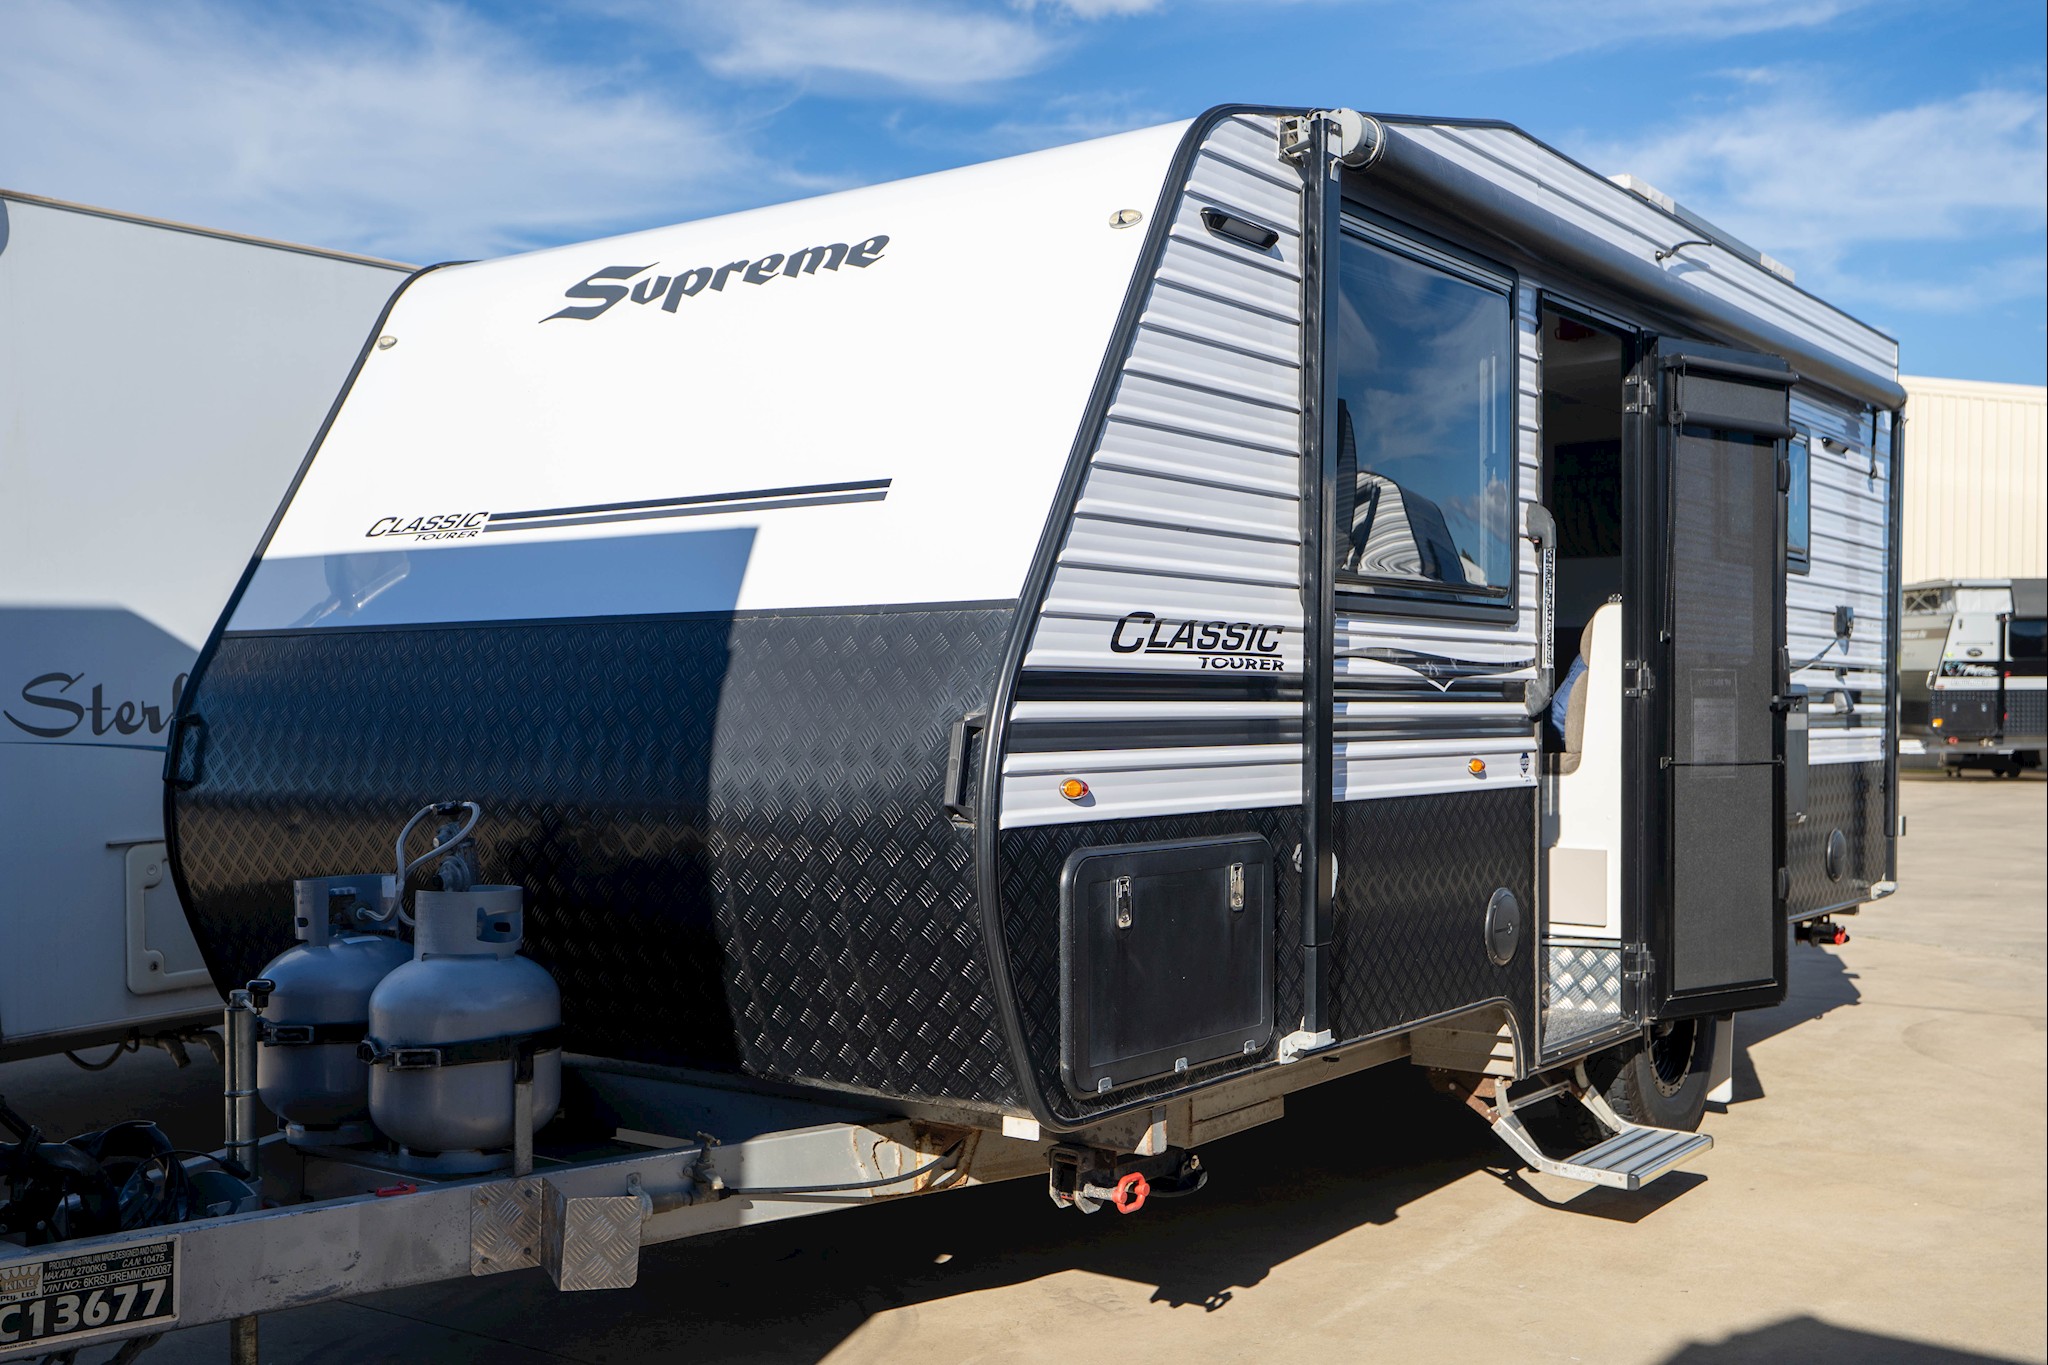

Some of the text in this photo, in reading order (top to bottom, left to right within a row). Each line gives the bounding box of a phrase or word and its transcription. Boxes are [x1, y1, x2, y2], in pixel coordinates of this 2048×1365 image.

[538, 233, 890, 324] Supreme
[365, 511, 489, 538] CLASSIC
[414, 530, 479, 542] TOURER
[1110, 611, 1286, 654] CLASSIC
[1198, 656, 1285, 671] TOURER
[43, 1270, 60, 1281] MAX
[76, 1263, 107, 1276] 2700KG
[142, 1253, 165, 1264] 10475
[48, 1259, 73, 1271] PROUDLY
[72, 1255, 101, 1267] AUSTRALIAN
[138, 1246, 150, 1256] AND
[0, 1290, 39, 1303] Pty. Ltd.
[5, 1277, 35, 1291] KING
[43, 1282, 61, 1294] VIN
[62, 1279, 82, 1290] NO:
[0, 1278, 167, 1343] C13677
